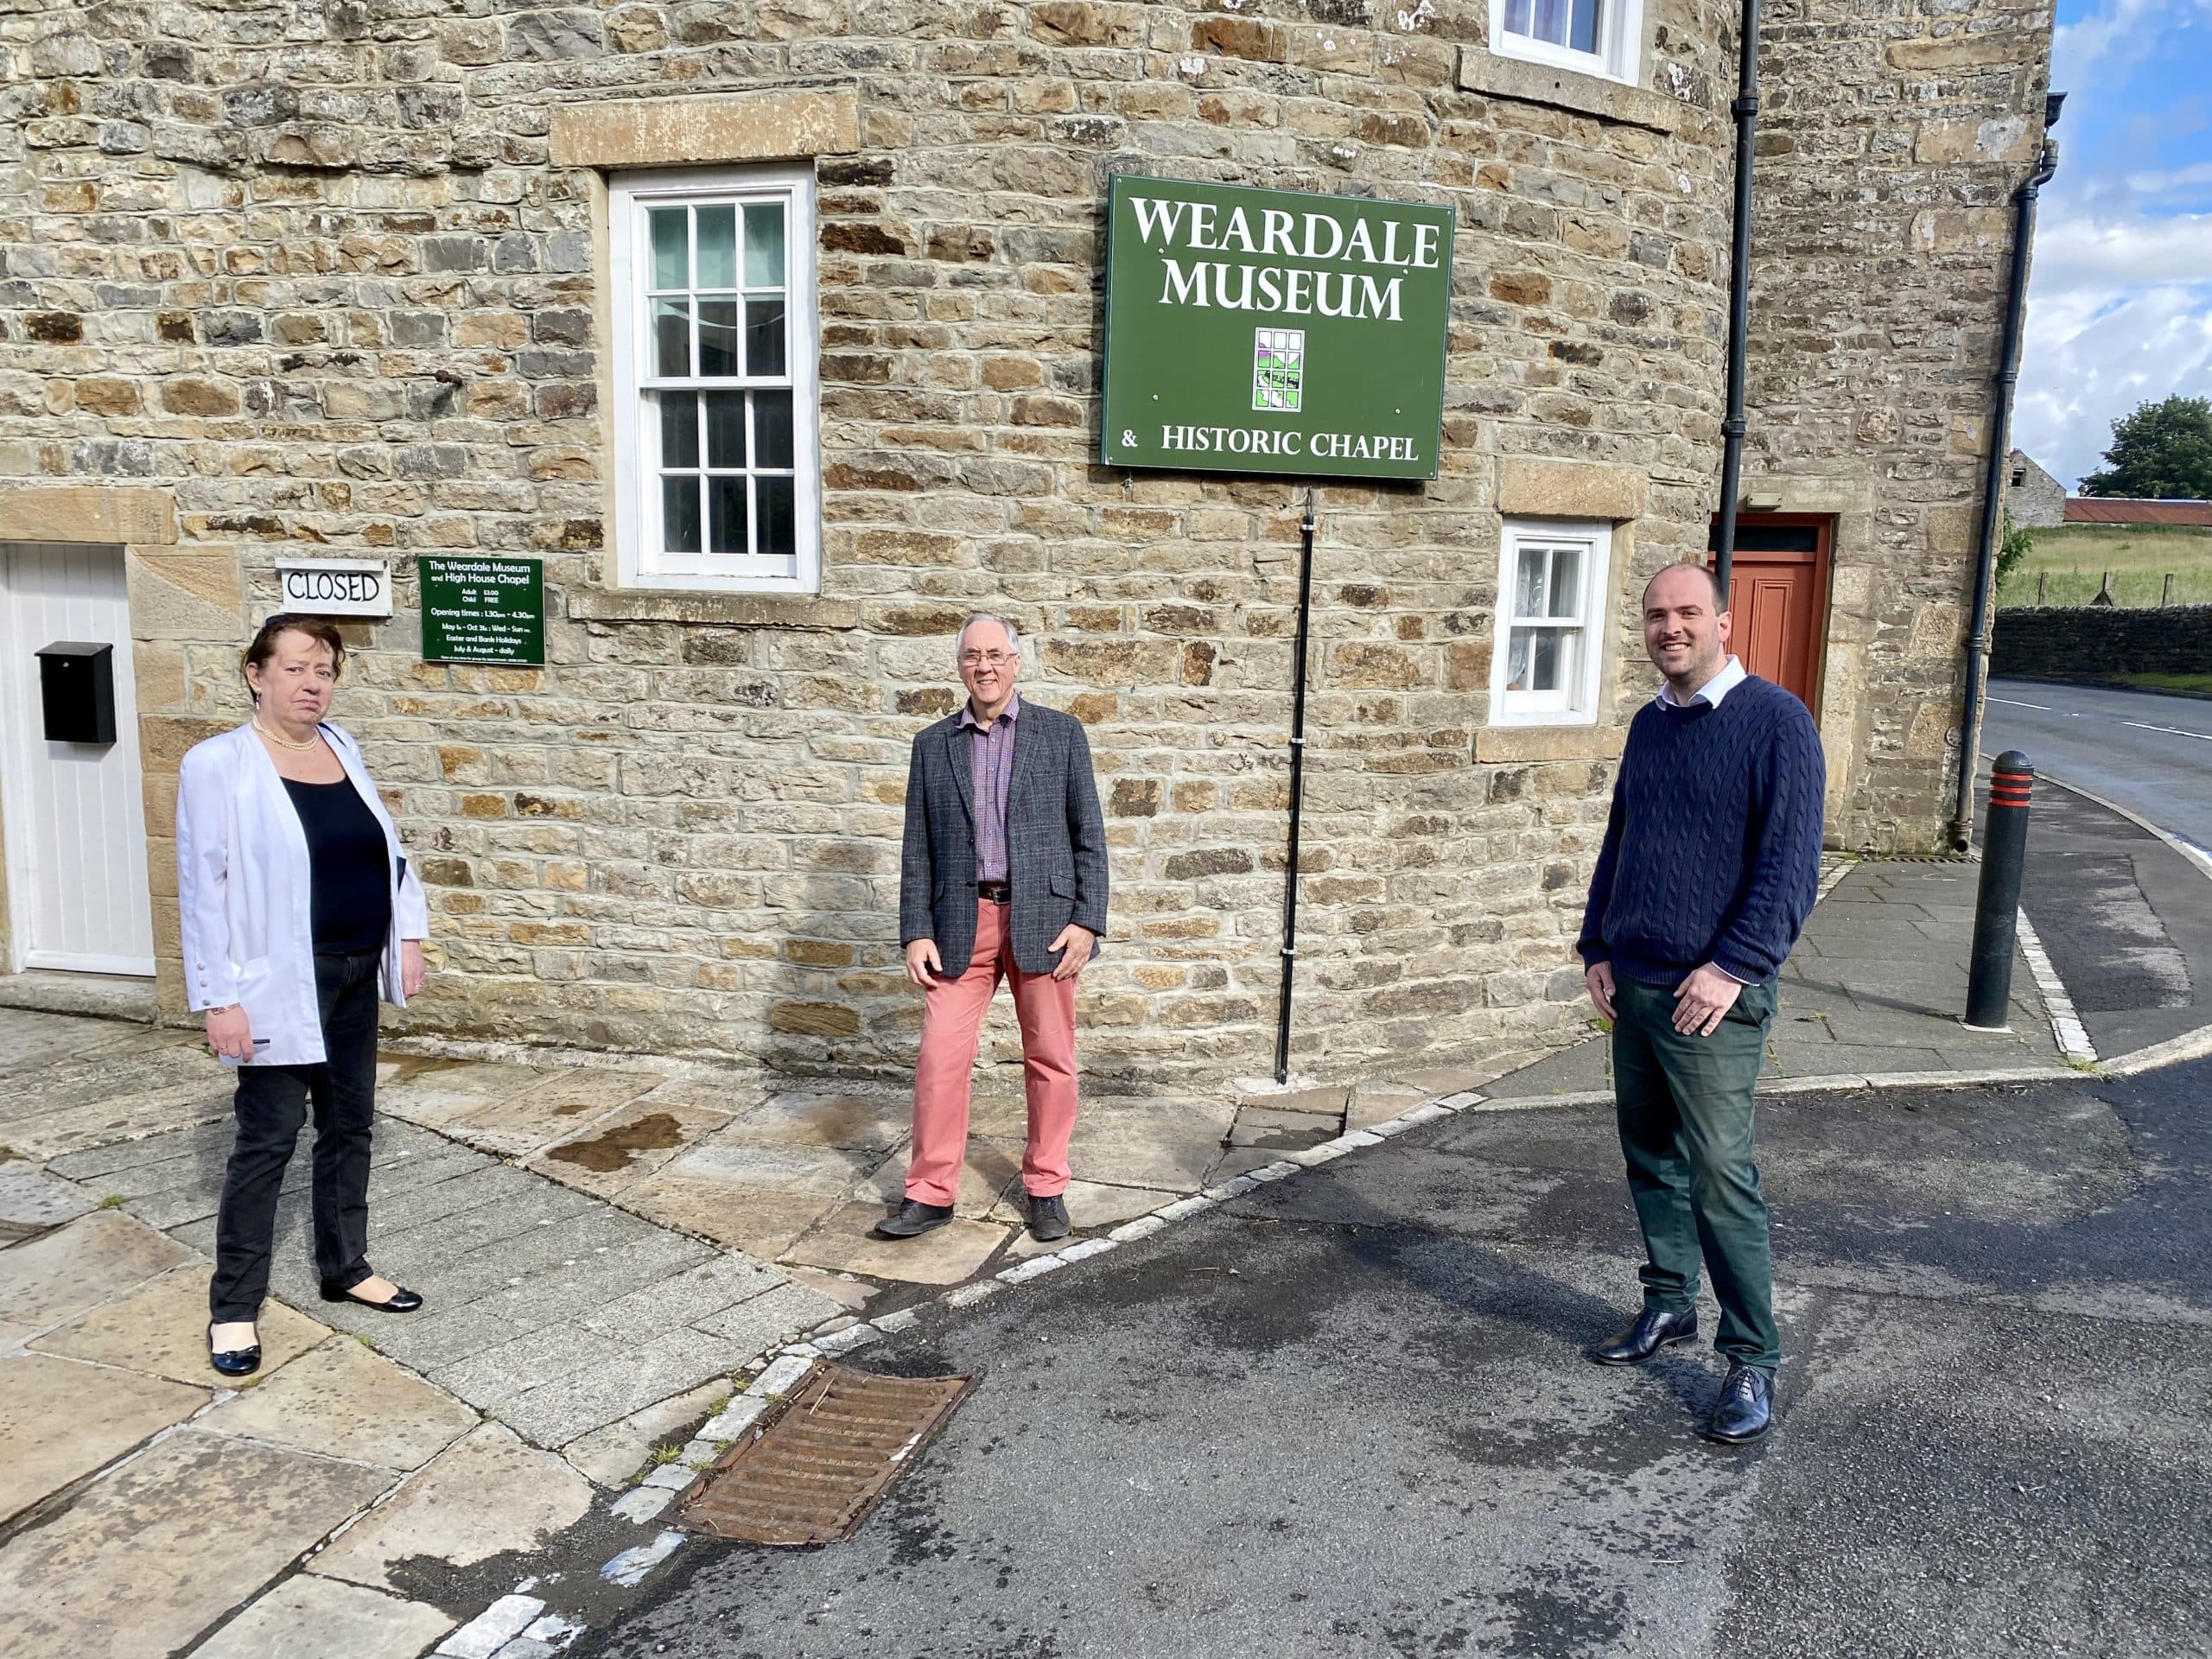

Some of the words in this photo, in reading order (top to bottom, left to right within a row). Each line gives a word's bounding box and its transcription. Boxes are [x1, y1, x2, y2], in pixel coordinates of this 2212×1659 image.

[1128, 196, 1440, 269] WEARDALE
[1158, 258, 1404, 321] MUSEUM
[1121, 429, 1139, 448] &
[1160, 424, 1301, 455] HISTORIC
[1310, 432, 1420, 461] CHAPEL
[429, 560, 445, 570] The
[447, 561, 491, 571] Weardale
[493, 563, 531, 573] Museum
[288, 572, 379, 601] CLOSED
[445, 573, 466, 583] High
[468, 574, 496, 583] House
[498, 575, 529, 586] Chapel
[431, 607, 460, 618] Opening
[499, 647, 515, 656] daily
